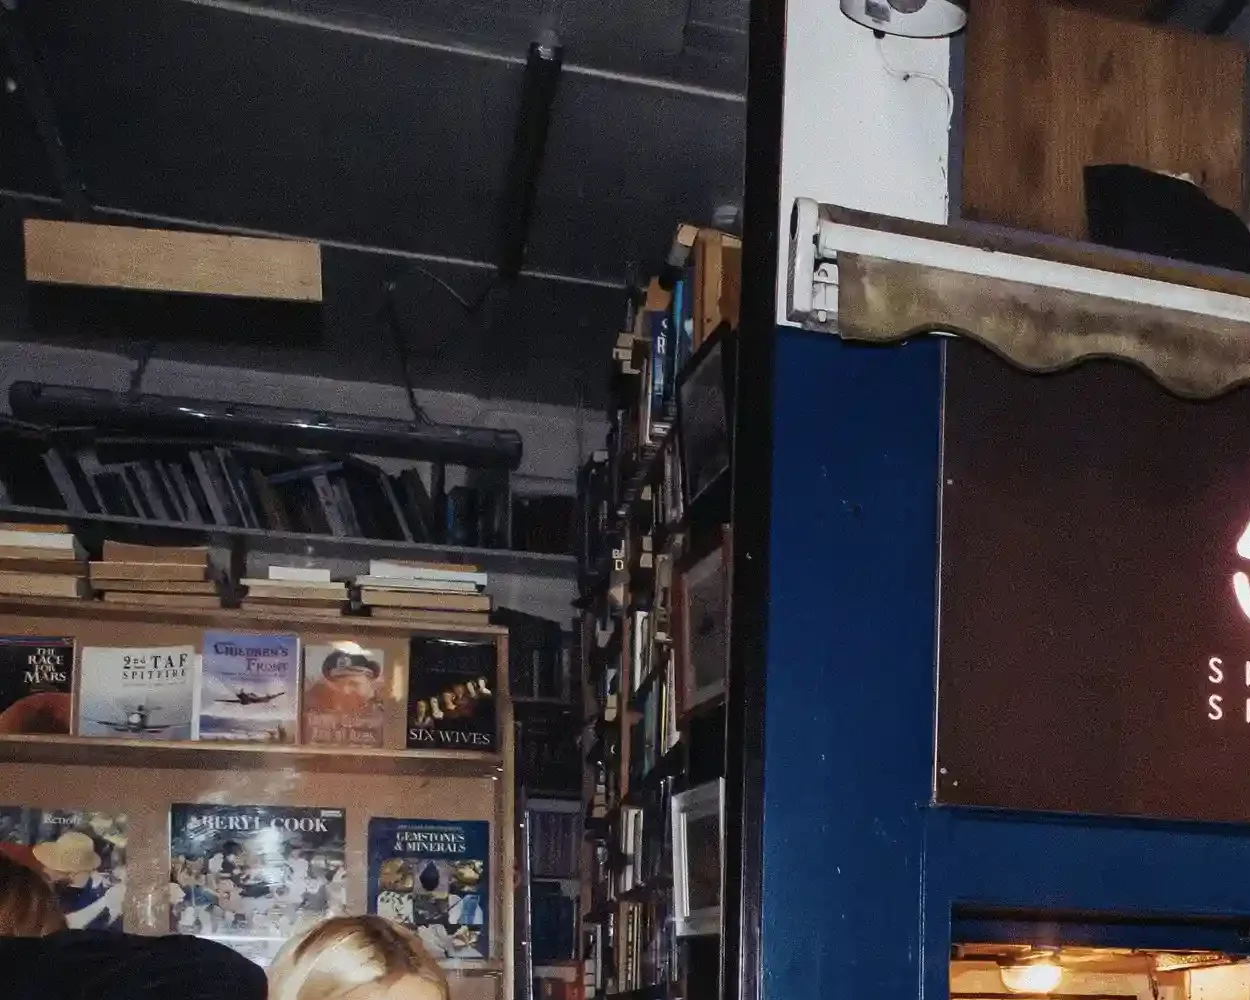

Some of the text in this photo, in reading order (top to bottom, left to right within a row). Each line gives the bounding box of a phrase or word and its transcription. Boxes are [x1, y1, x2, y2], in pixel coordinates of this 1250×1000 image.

[28, 655, 65, 665] RACE
[151, 653, 188, 669] TAF
[24, 671, 67, 683] MARS
[122, 669, 187, 680] SPITFIRE
[409, 728, 491, 745] SIX WIVES
[270, 816, 328, 833] COOK
[396, 831, 466, 843] GEMSTONES
[393, 841, 467, 854] & MINERALS
